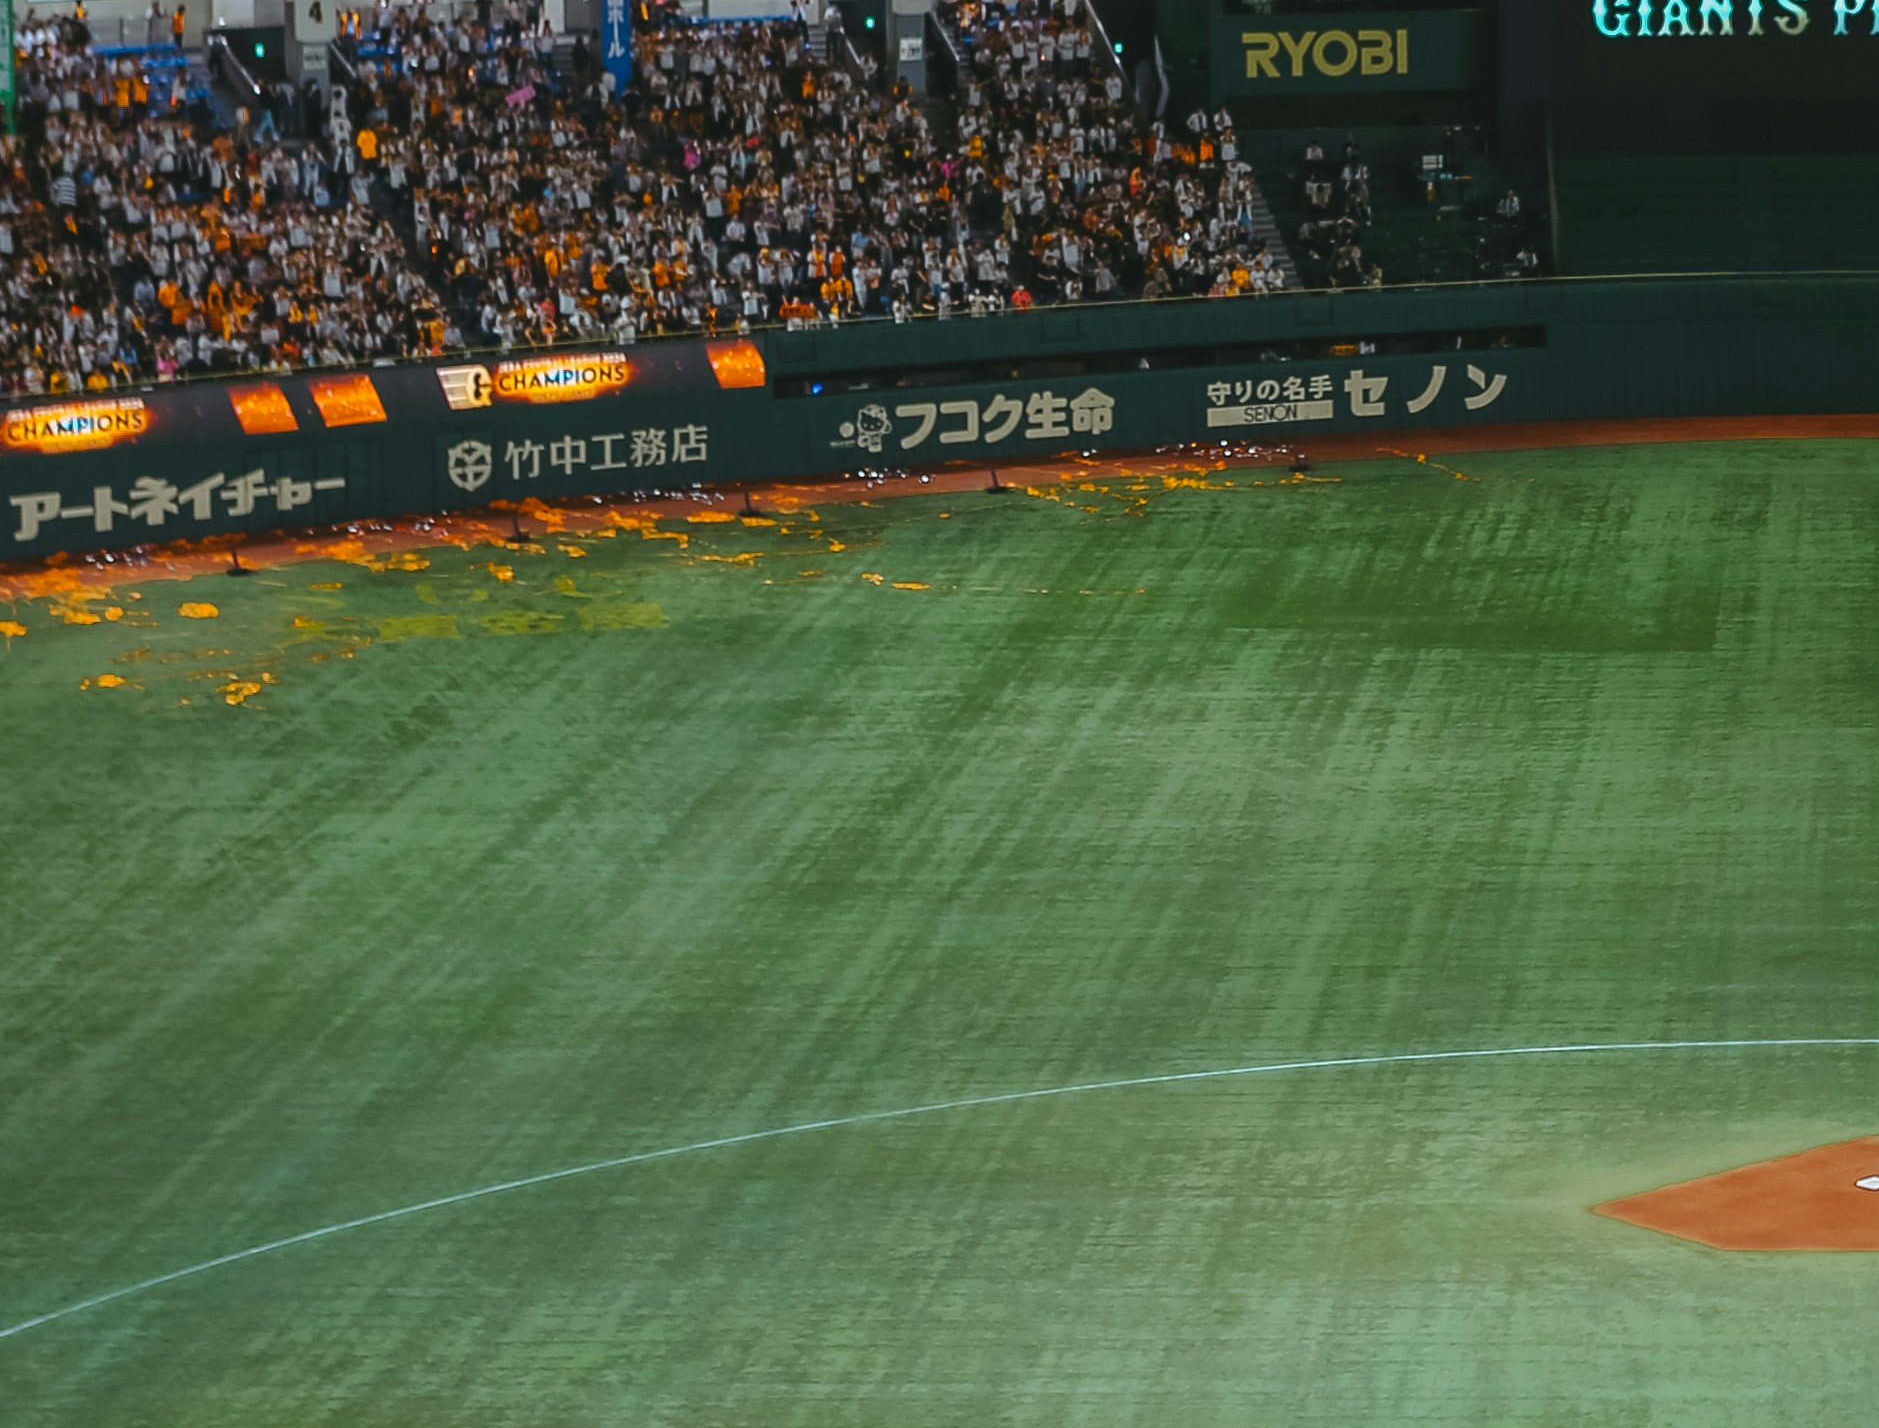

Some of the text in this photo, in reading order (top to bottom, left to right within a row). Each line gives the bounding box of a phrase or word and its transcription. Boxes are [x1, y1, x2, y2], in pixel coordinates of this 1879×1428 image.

[308, 0, 323, 24] 4
[1241, 28, 1409, 79] RYOBI
[498, 364, 626, 392] CHAMPIONS
[1206, 374, 1334, 406] 守りの名手
[1343, 363, 1508, 418] セノン
[7, 411, 145, 441] CHAMPIONS
[895, 387, 1116, 450] フコク生命
[1243, 403, 1299, 424] SENON
[503, 423, 709, 481] 竹中工務店
[9, 468, 347, 543] アートネイチャー
